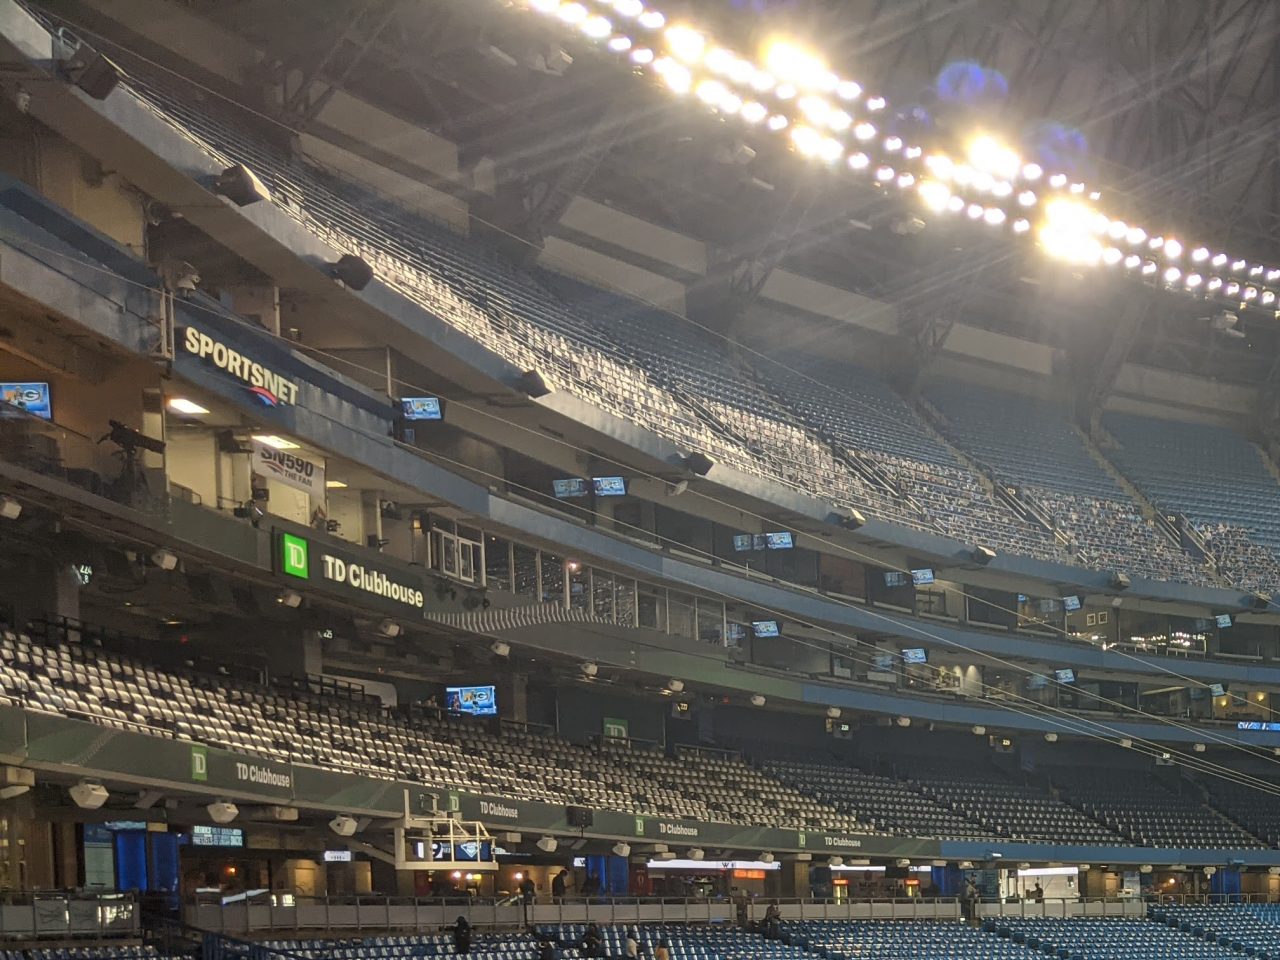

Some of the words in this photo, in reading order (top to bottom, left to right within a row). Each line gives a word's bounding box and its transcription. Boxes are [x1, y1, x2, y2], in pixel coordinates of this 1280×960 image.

[185, 326, 299, 406] SPORTSNET
[261, 450, 314, 478] SN590
[284, 469, 299, 482] THE
[299, 472, 313, 488] FAN
[287, 542, 305, 570] TD
[321, 554, 346, 582] TD
[349, 564, 424, 608] Clubhouse
[193, 753, 206, 774] TD
[236, 762, 248, 780] TD
[249, 765, 291, 788] Clubhouse
[480, 801, 489, 815] TD
[489, 802, 518, 819] Clubhouse
[659, 823, 667, 834] TD
[667, 823, 698, 837] Clubhouse
[824, 836, 833, 846] TD
[833, 836, 861, 848] Clubhouse
